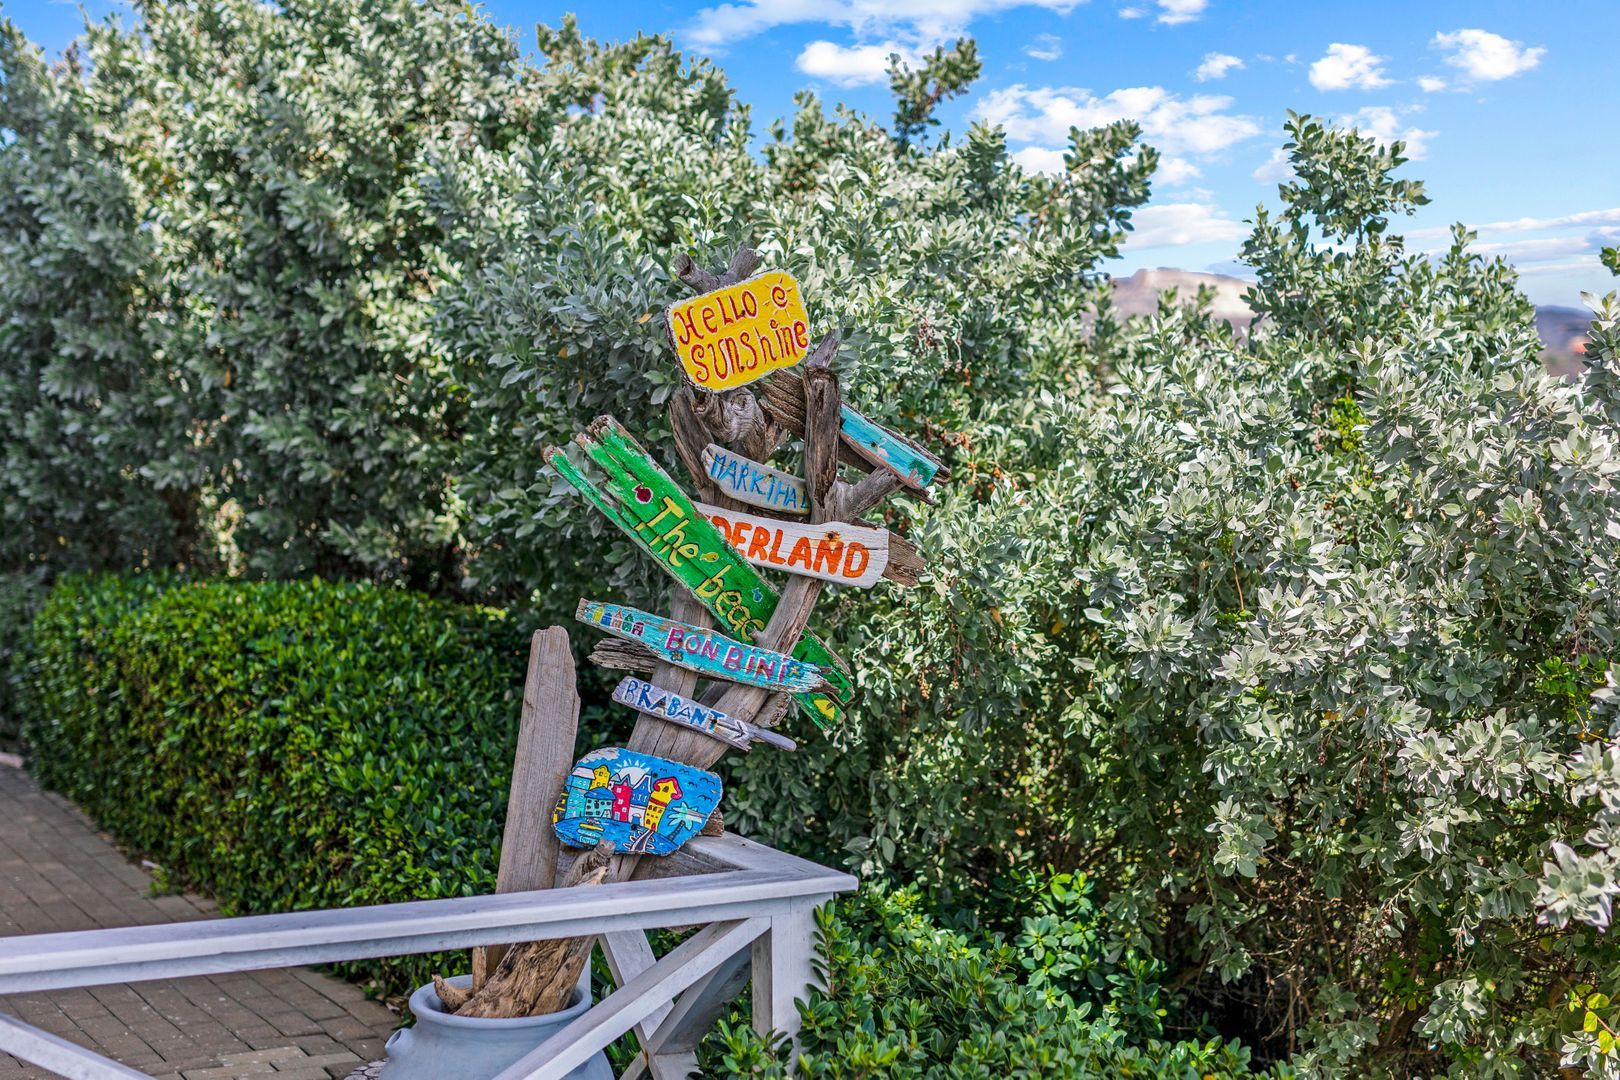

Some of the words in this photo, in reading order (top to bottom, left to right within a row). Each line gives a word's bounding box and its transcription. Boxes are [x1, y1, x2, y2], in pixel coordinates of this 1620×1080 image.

[633, 495, 700, 567] The
[695, 563, 766, 643] beac
[706, 514, 870, 578] DERLAND
[664, 627, 721, 663] BON
[623, 679, 726, 733] BRABANT
